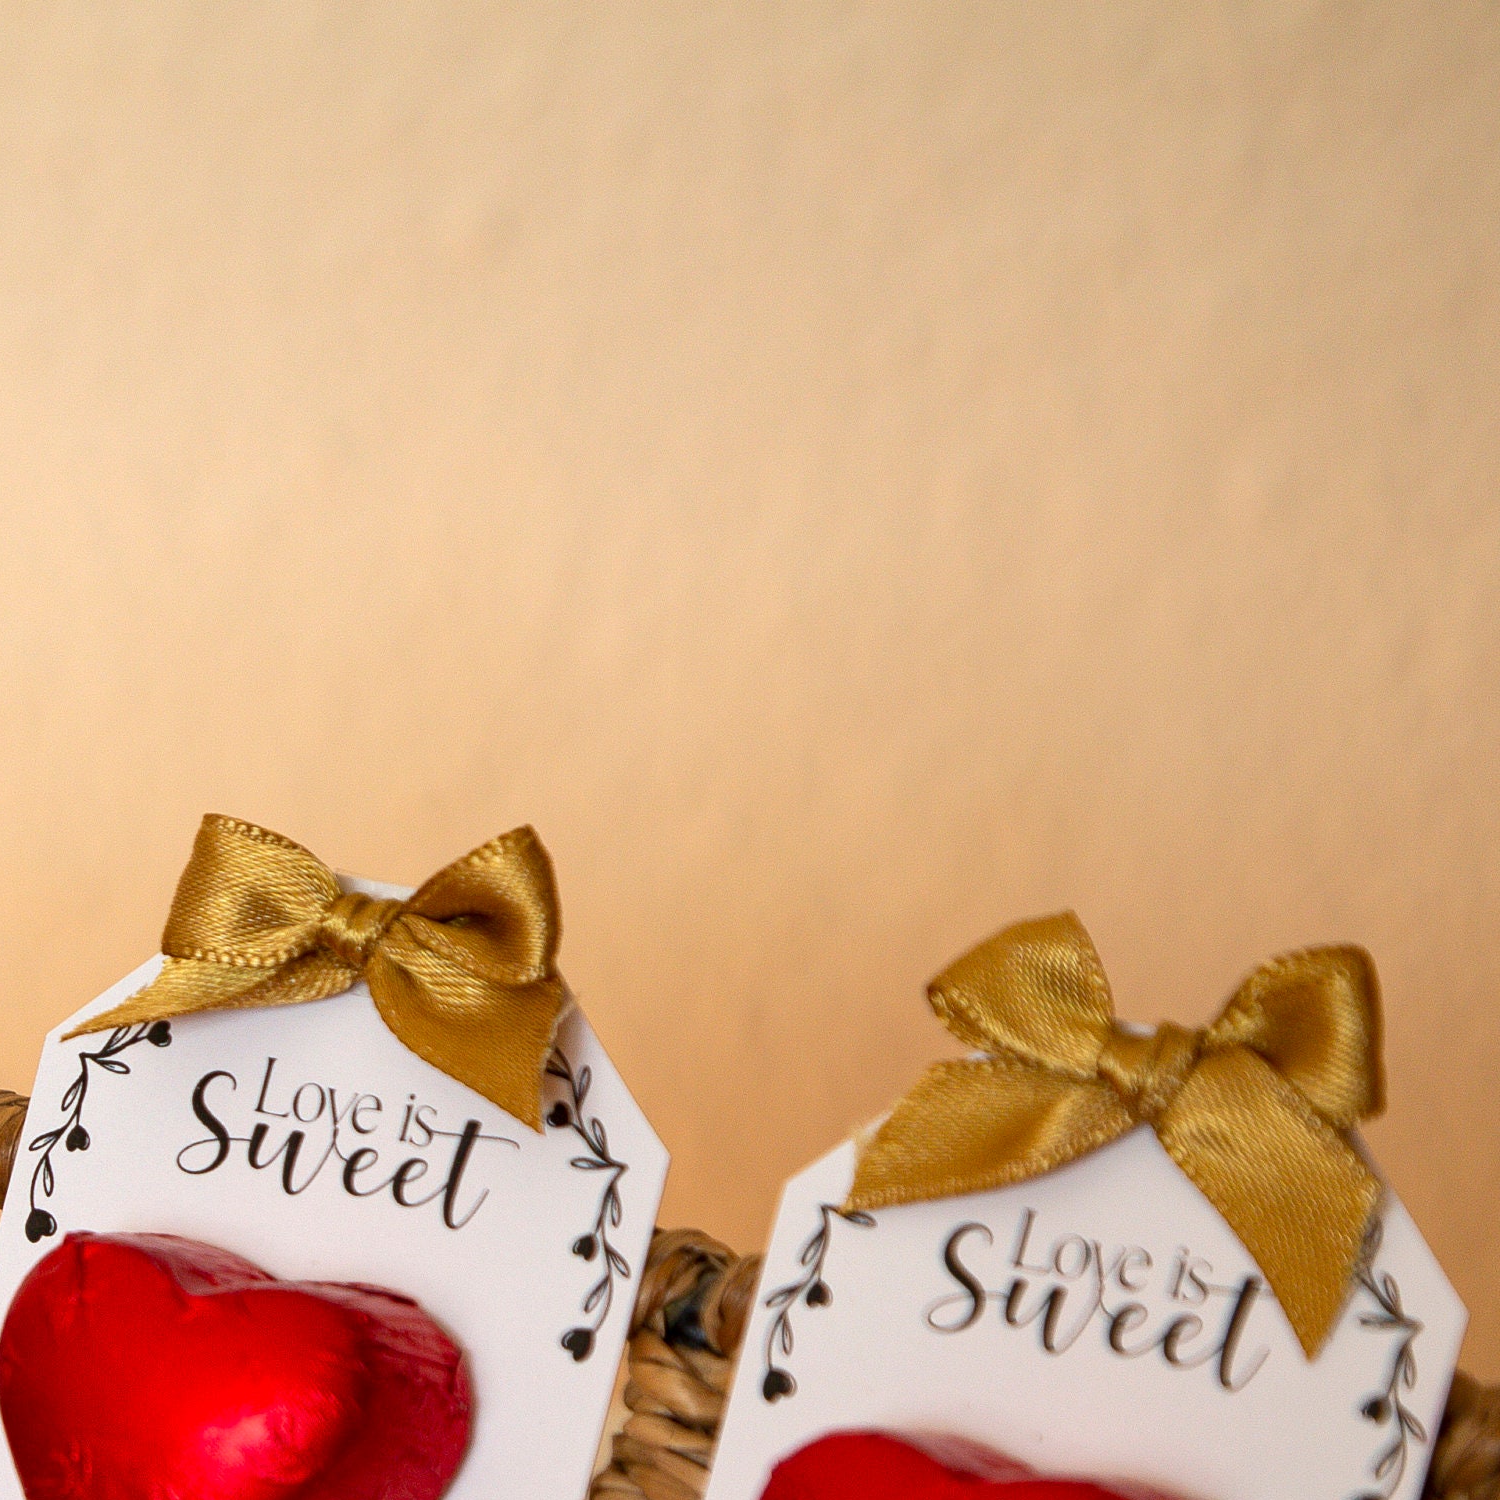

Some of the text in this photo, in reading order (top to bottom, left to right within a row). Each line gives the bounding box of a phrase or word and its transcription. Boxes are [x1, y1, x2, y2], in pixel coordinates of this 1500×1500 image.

[176, 1070, 521, 1230] Sweet
[254, 1057, 438, 1148] Love is
[924, 1221, 1273, 1393] Sweet
[1011, 1206, 1214, 1305] Love is
